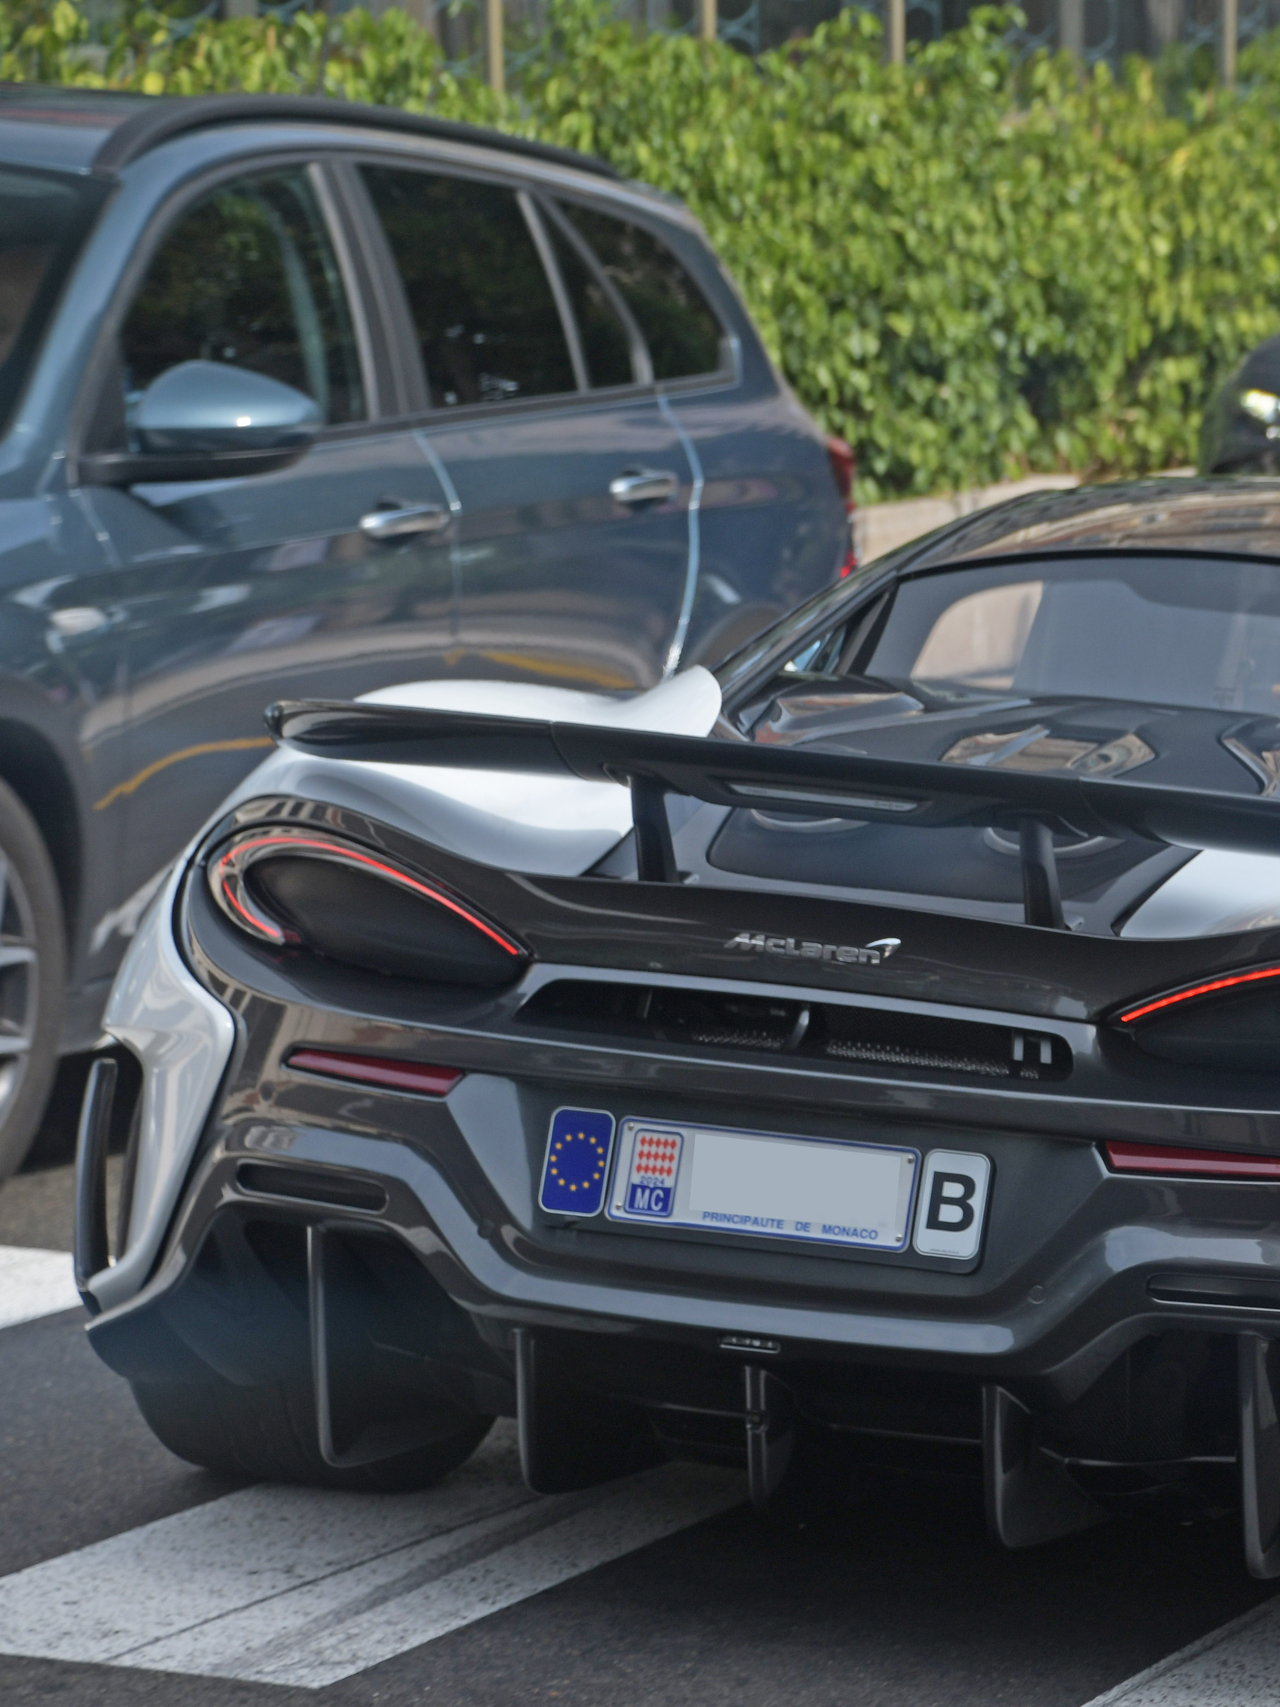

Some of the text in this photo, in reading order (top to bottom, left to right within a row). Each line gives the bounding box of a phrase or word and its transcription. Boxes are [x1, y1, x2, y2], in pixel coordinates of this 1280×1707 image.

[724, 932, 881, 964] McLaren
[634, 1187, 665, 1212] MC
[926, 1171, 976, 1233] B
[702, 1211, 879, 1240] PRINCIPAUTE DE MONACO
